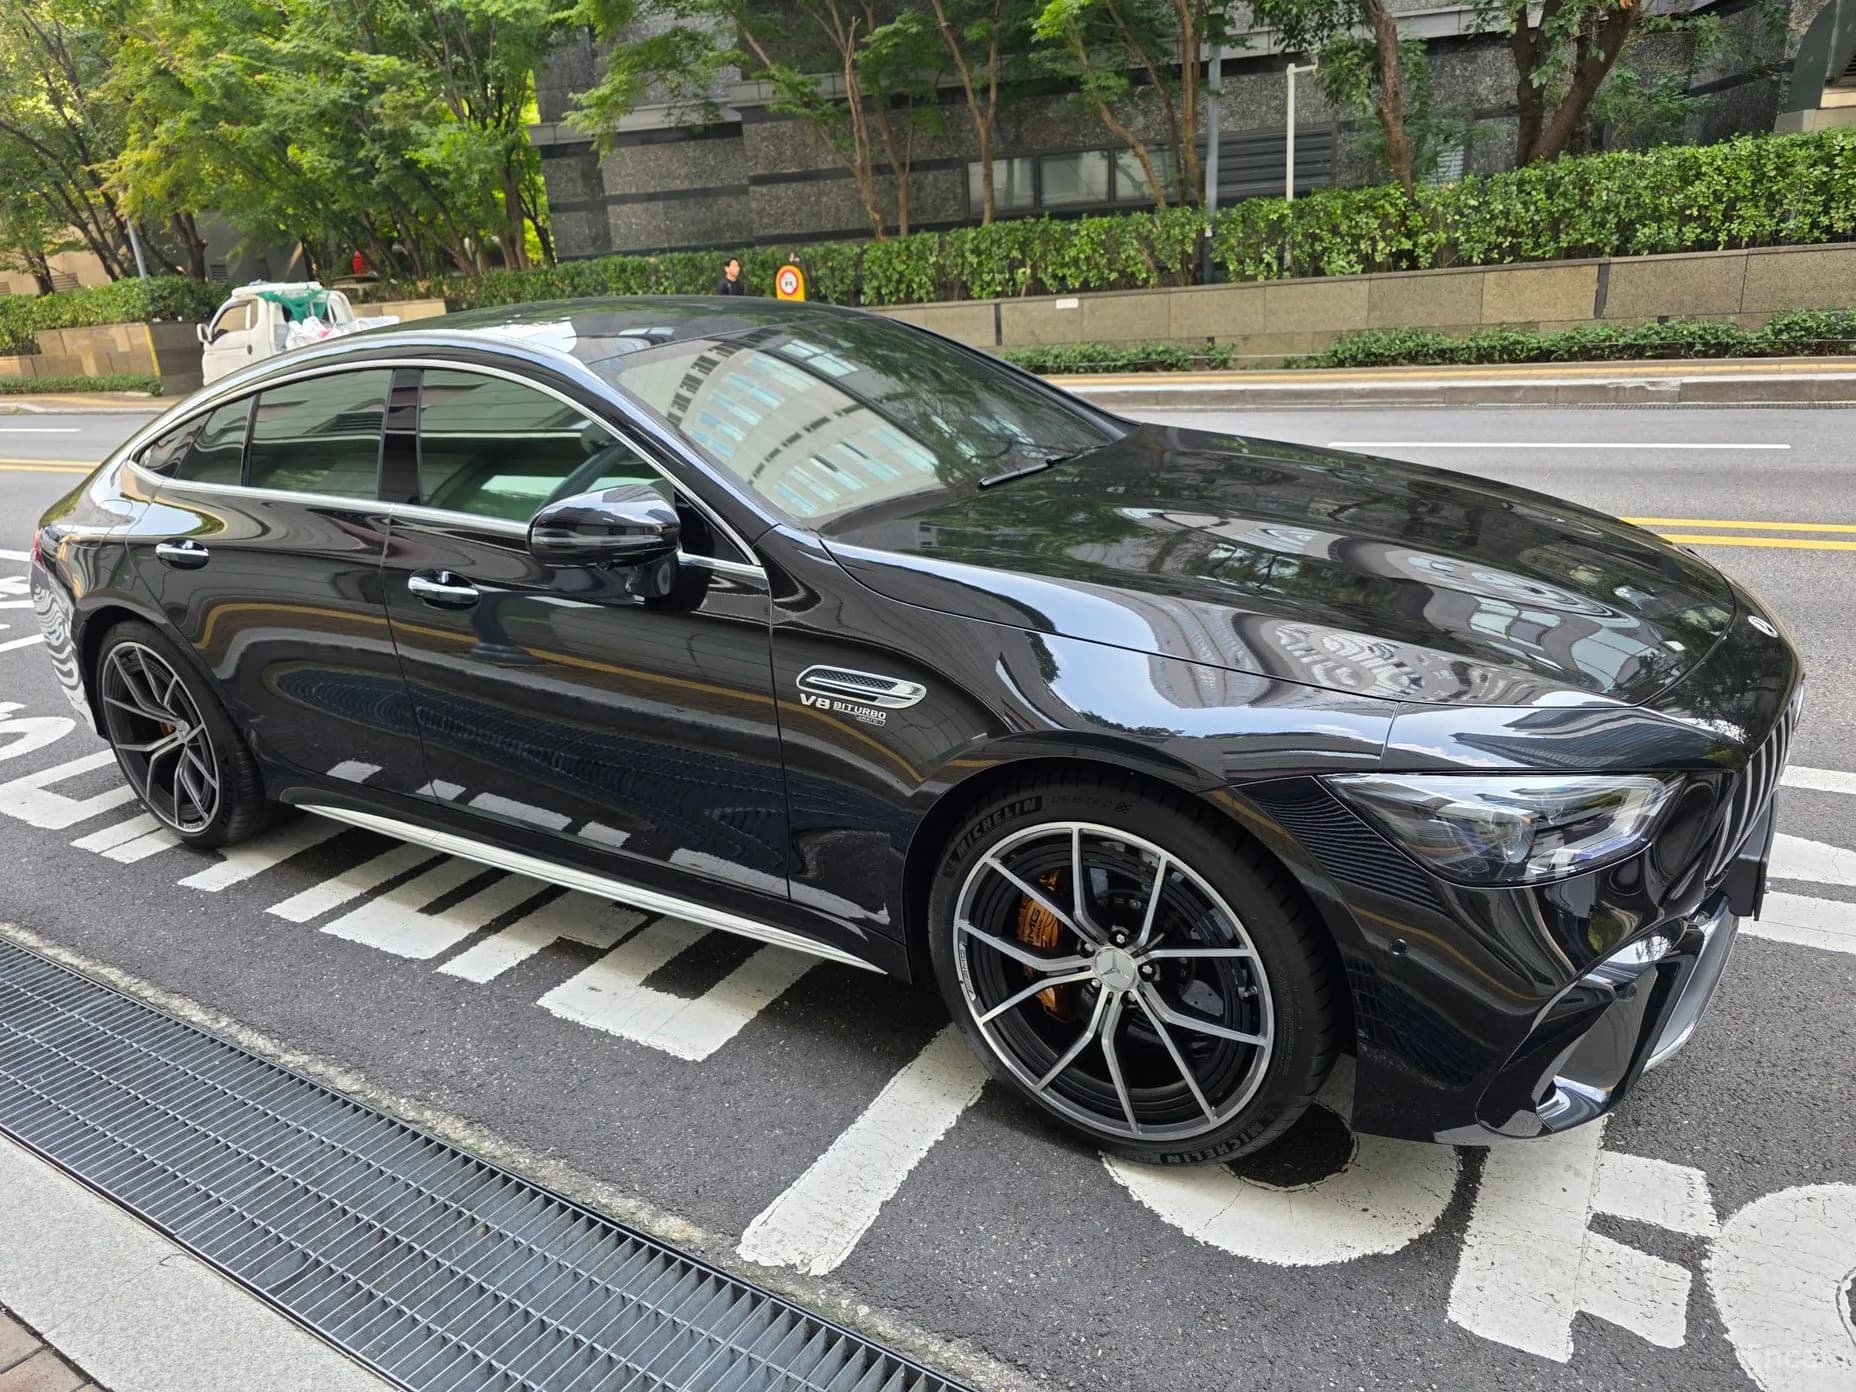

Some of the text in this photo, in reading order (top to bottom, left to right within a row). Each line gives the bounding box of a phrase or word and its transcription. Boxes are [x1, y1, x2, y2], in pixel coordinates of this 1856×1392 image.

[800, 693, 887, 719] V8 BITURBO
[955, 797, 1039, 860] MICHELIN
[1167, 1120, 1265, 1163] MICHELIN
